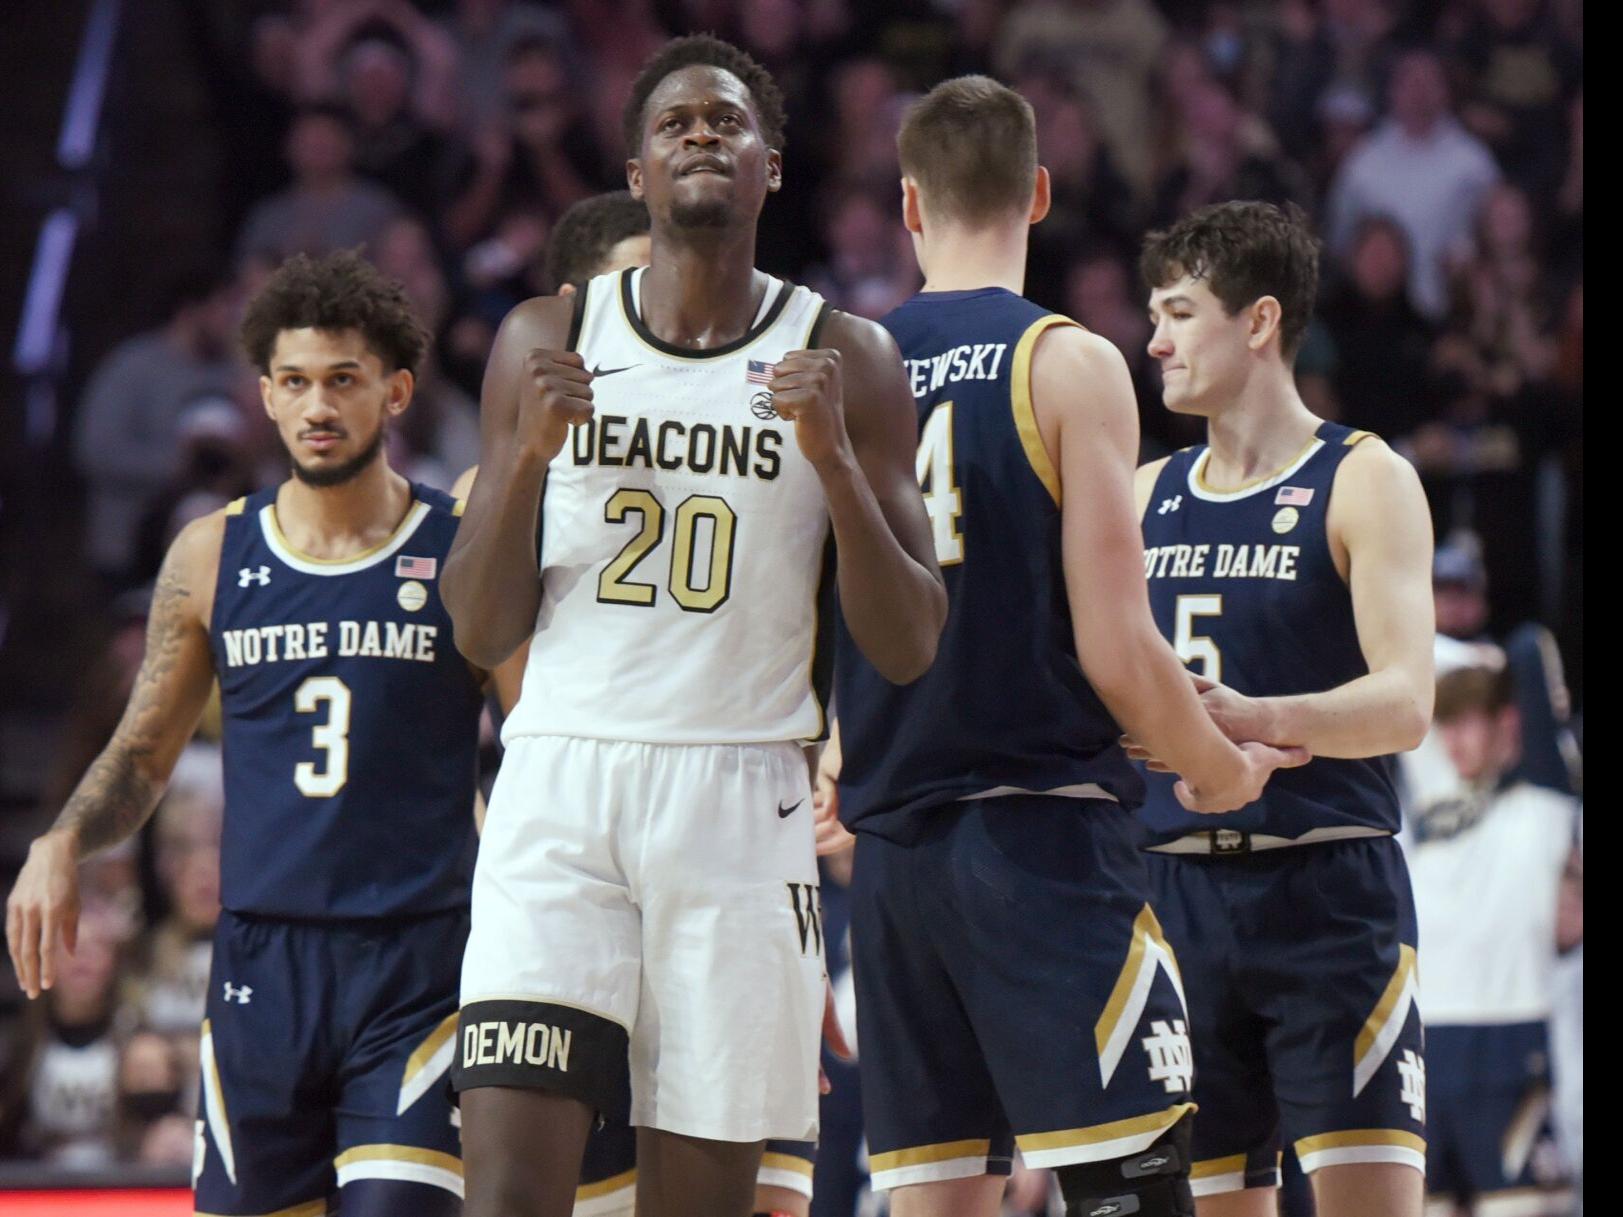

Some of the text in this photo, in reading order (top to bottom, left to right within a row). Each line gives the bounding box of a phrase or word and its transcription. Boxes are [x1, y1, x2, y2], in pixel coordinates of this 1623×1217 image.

[903, 344, 1007, 398] EWSKI
[573, 414, 783, 481] DEACONS
[596, 487, 738, 614] 20
[1143, 544, 1300, 580] OTRE DAME
[223, 620, 438, 667] NOTRE DAME
[1174, 593, 1223, 688] 5
[294, 675, 352, 798] 3
[463, 1021, 572, 1072] DEMON
